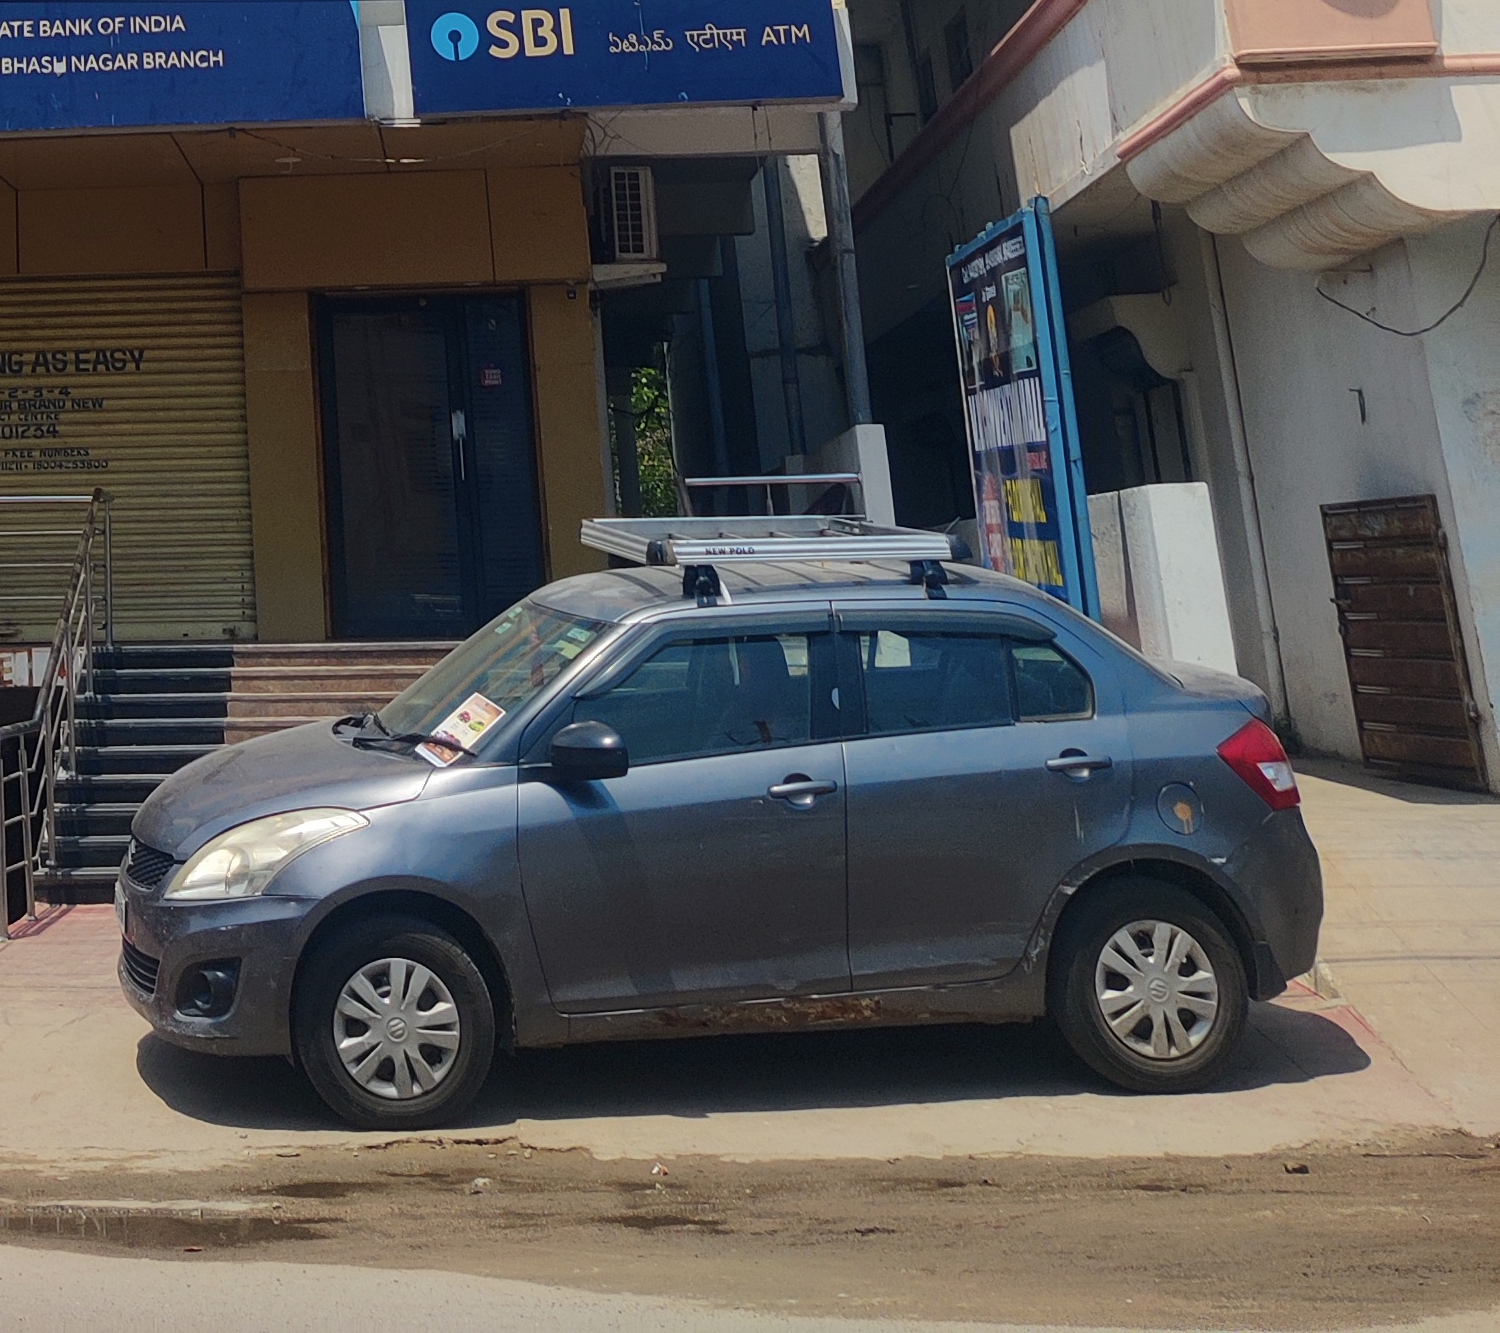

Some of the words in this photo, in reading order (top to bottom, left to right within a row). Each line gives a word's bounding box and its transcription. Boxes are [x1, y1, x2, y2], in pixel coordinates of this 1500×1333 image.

[39, 17, 94, 37] BANK
[97, 16, 125, 35] OF
[130, 14, 186, 33] INDIA
[486, 8, 574, 59] SBI
[684, 23, 746, 52] एटीएम
[761, 24, 811, 46] ATM
[71, 53, 139, 73] NAGAR
[143, 49, 224, 69] BRANCH
[31, 349, 68, 374] AS
[74, 348, 145, 372] EASY
[18, 398, 66, 410] BRAND
[71, 397, 105, 409] NEW
